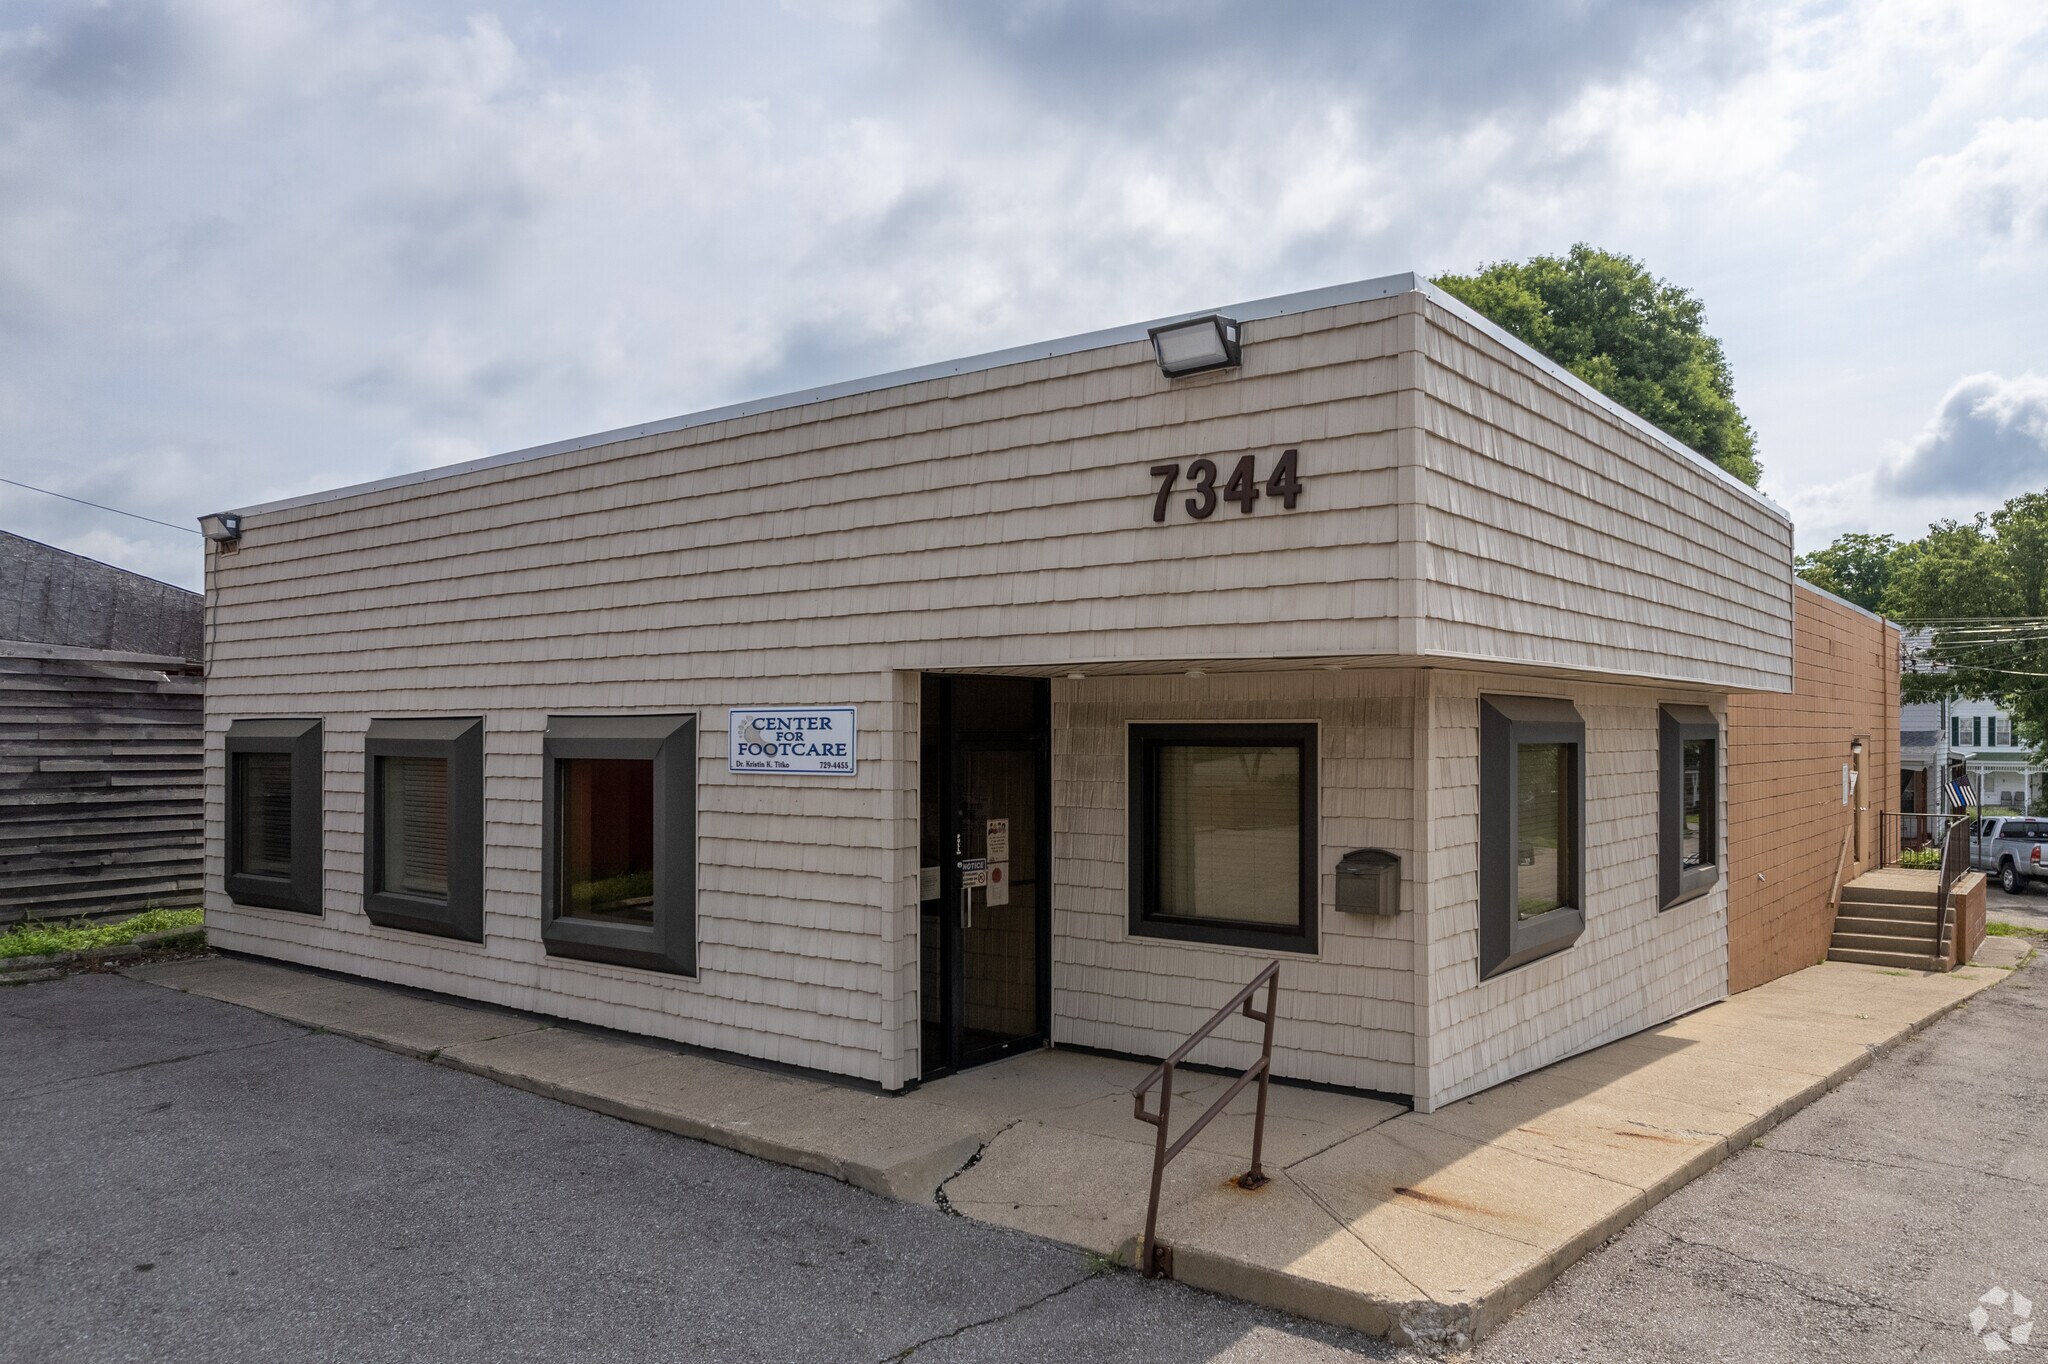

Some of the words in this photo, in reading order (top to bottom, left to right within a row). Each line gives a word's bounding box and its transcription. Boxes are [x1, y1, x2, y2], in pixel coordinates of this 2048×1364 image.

[1150, 449, 1302, 522] 7344
[752, 717, 832, 730] CENTER
[776, 731, 804, 741] FOR
[738, 743, 847, 756] FOOTCARE
[819, 761, 849, 769] 729-4455
[963, 862, 984, 870] NOTICE
